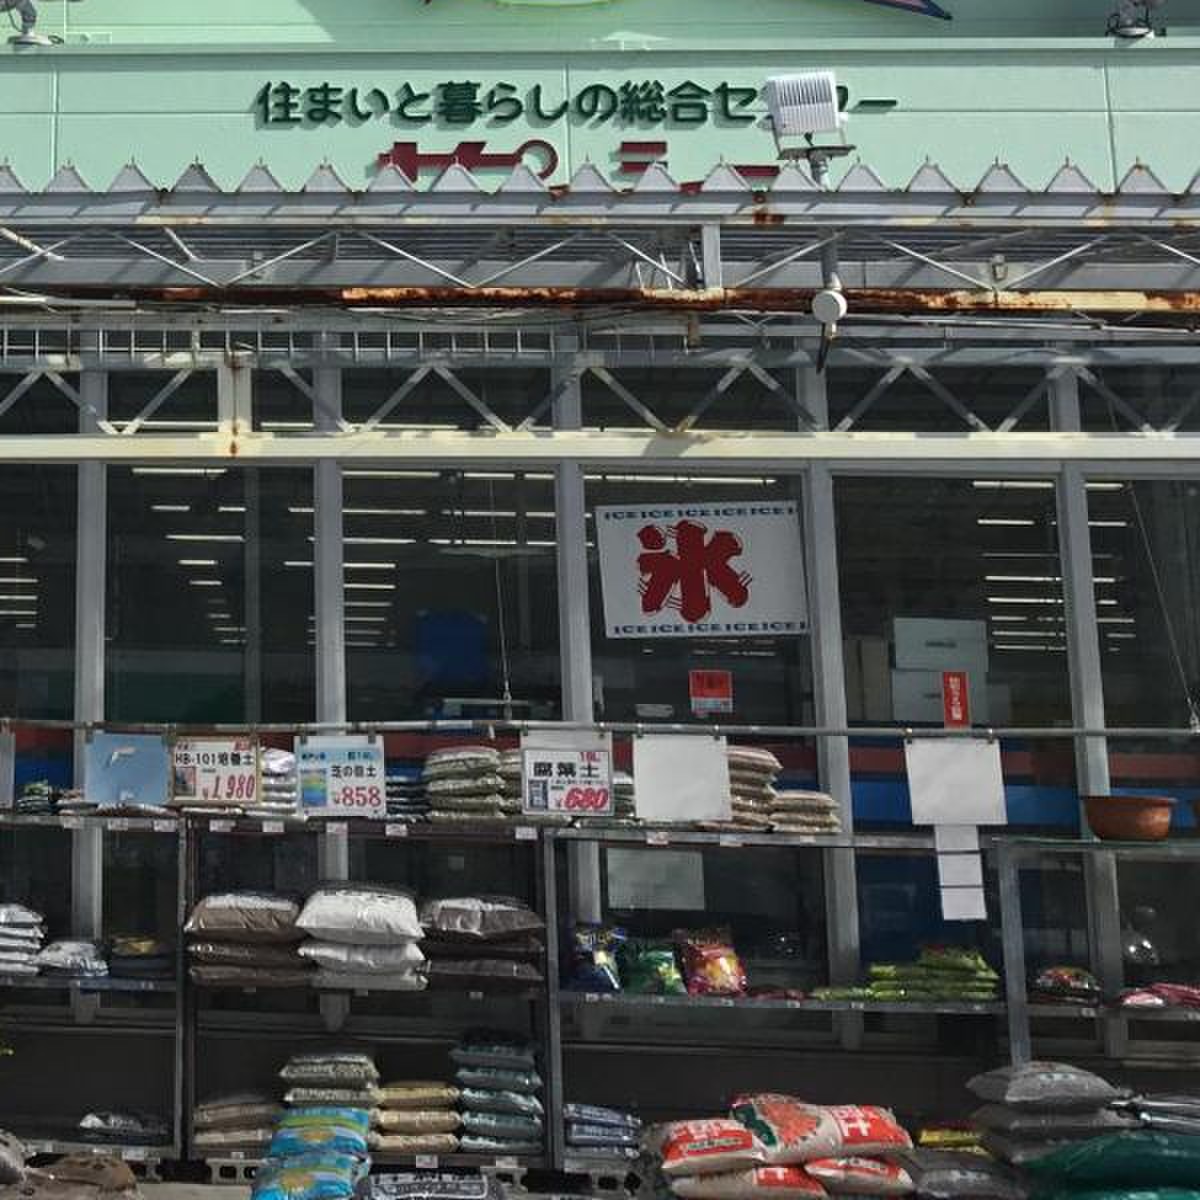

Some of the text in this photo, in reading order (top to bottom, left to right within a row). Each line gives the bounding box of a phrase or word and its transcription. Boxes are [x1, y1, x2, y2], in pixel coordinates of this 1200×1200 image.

[257, 80, 897, 125] 住まいと暮らしの総合セー
[637, 519, 751, 624] 氷
